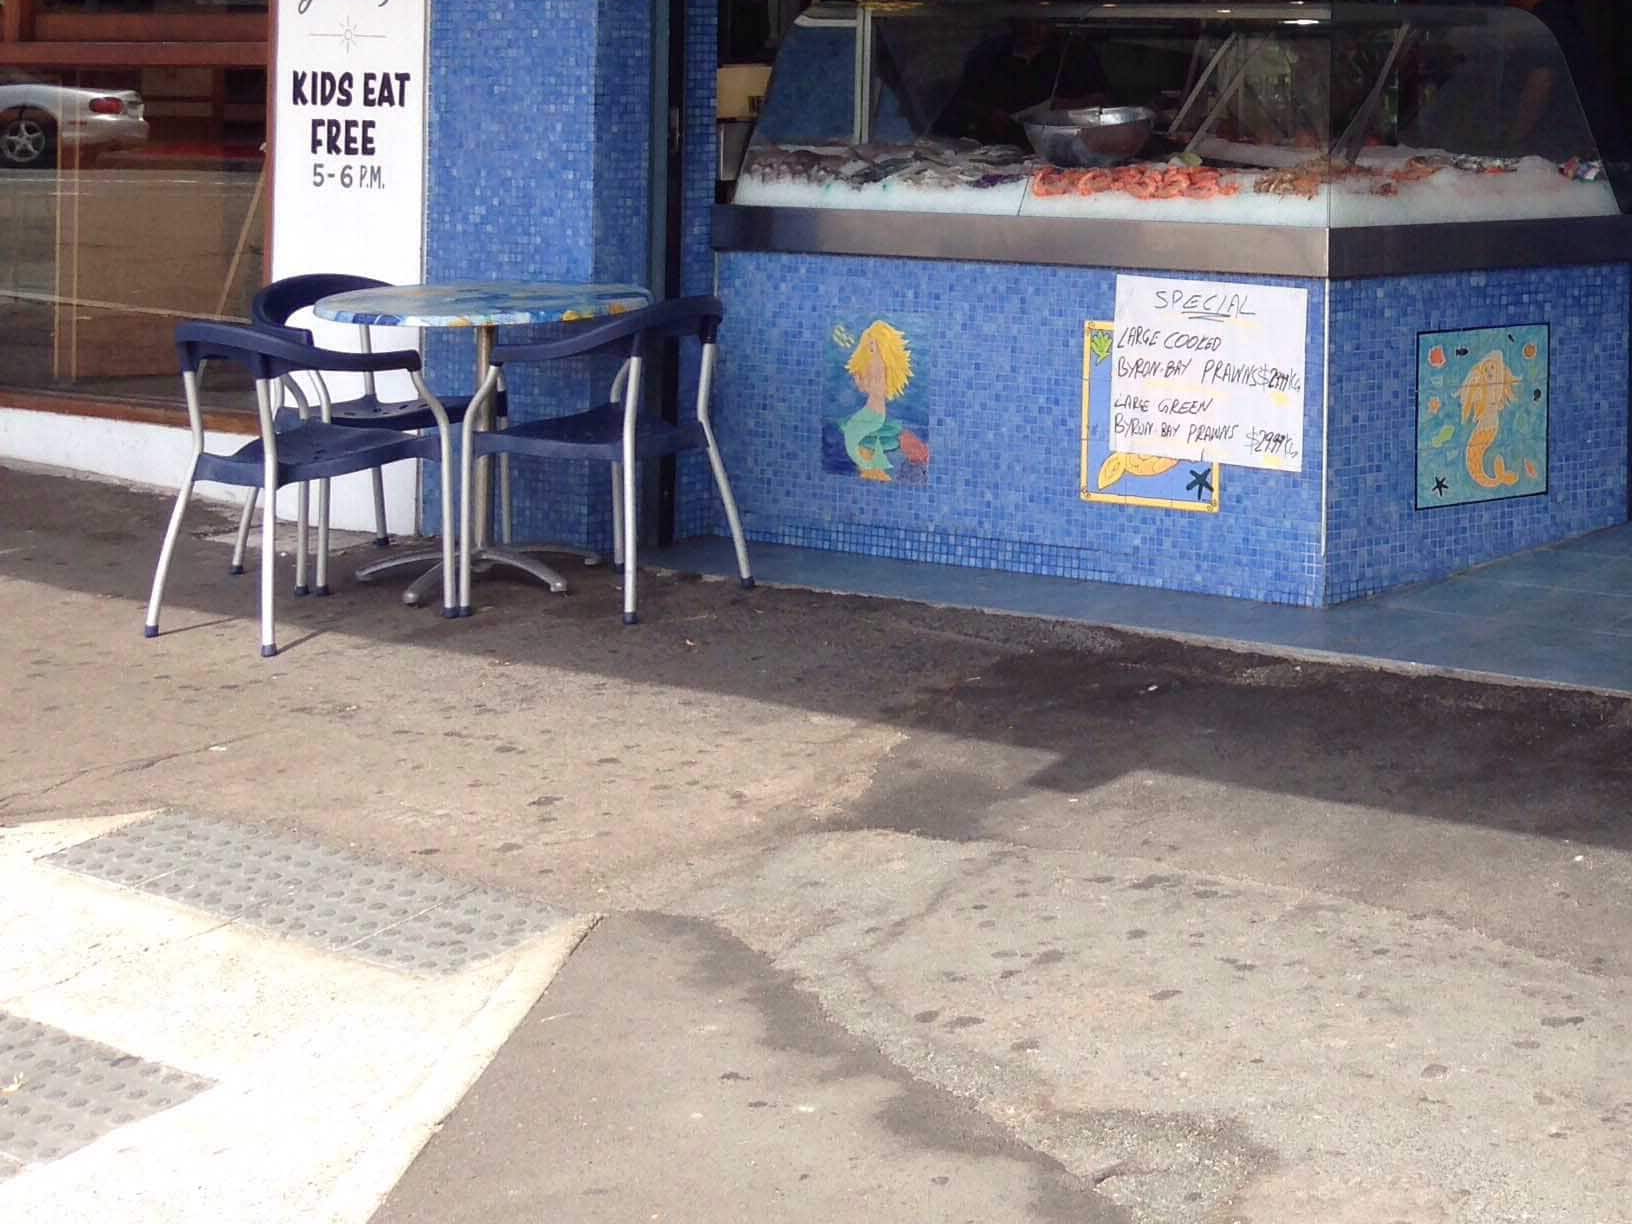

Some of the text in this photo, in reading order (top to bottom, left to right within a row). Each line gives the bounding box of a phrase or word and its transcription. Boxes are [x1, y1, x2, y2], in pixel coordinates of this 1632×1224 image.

[292, 70, 410, 108] KIDS EAT
[311, 118, 376, 156] FREE
[359, 164, 385, 190] P.M.
[1154, 289, 1256, 316] SPECIAL
[1117, 326, 1222, 351] LARGE COOKED
[1201, 359, 1257, 387] PRAWNS
[1114, 395, 1214, 415] LARGE GREEN
[1187, 424, 1239, 444] PRAWNS
